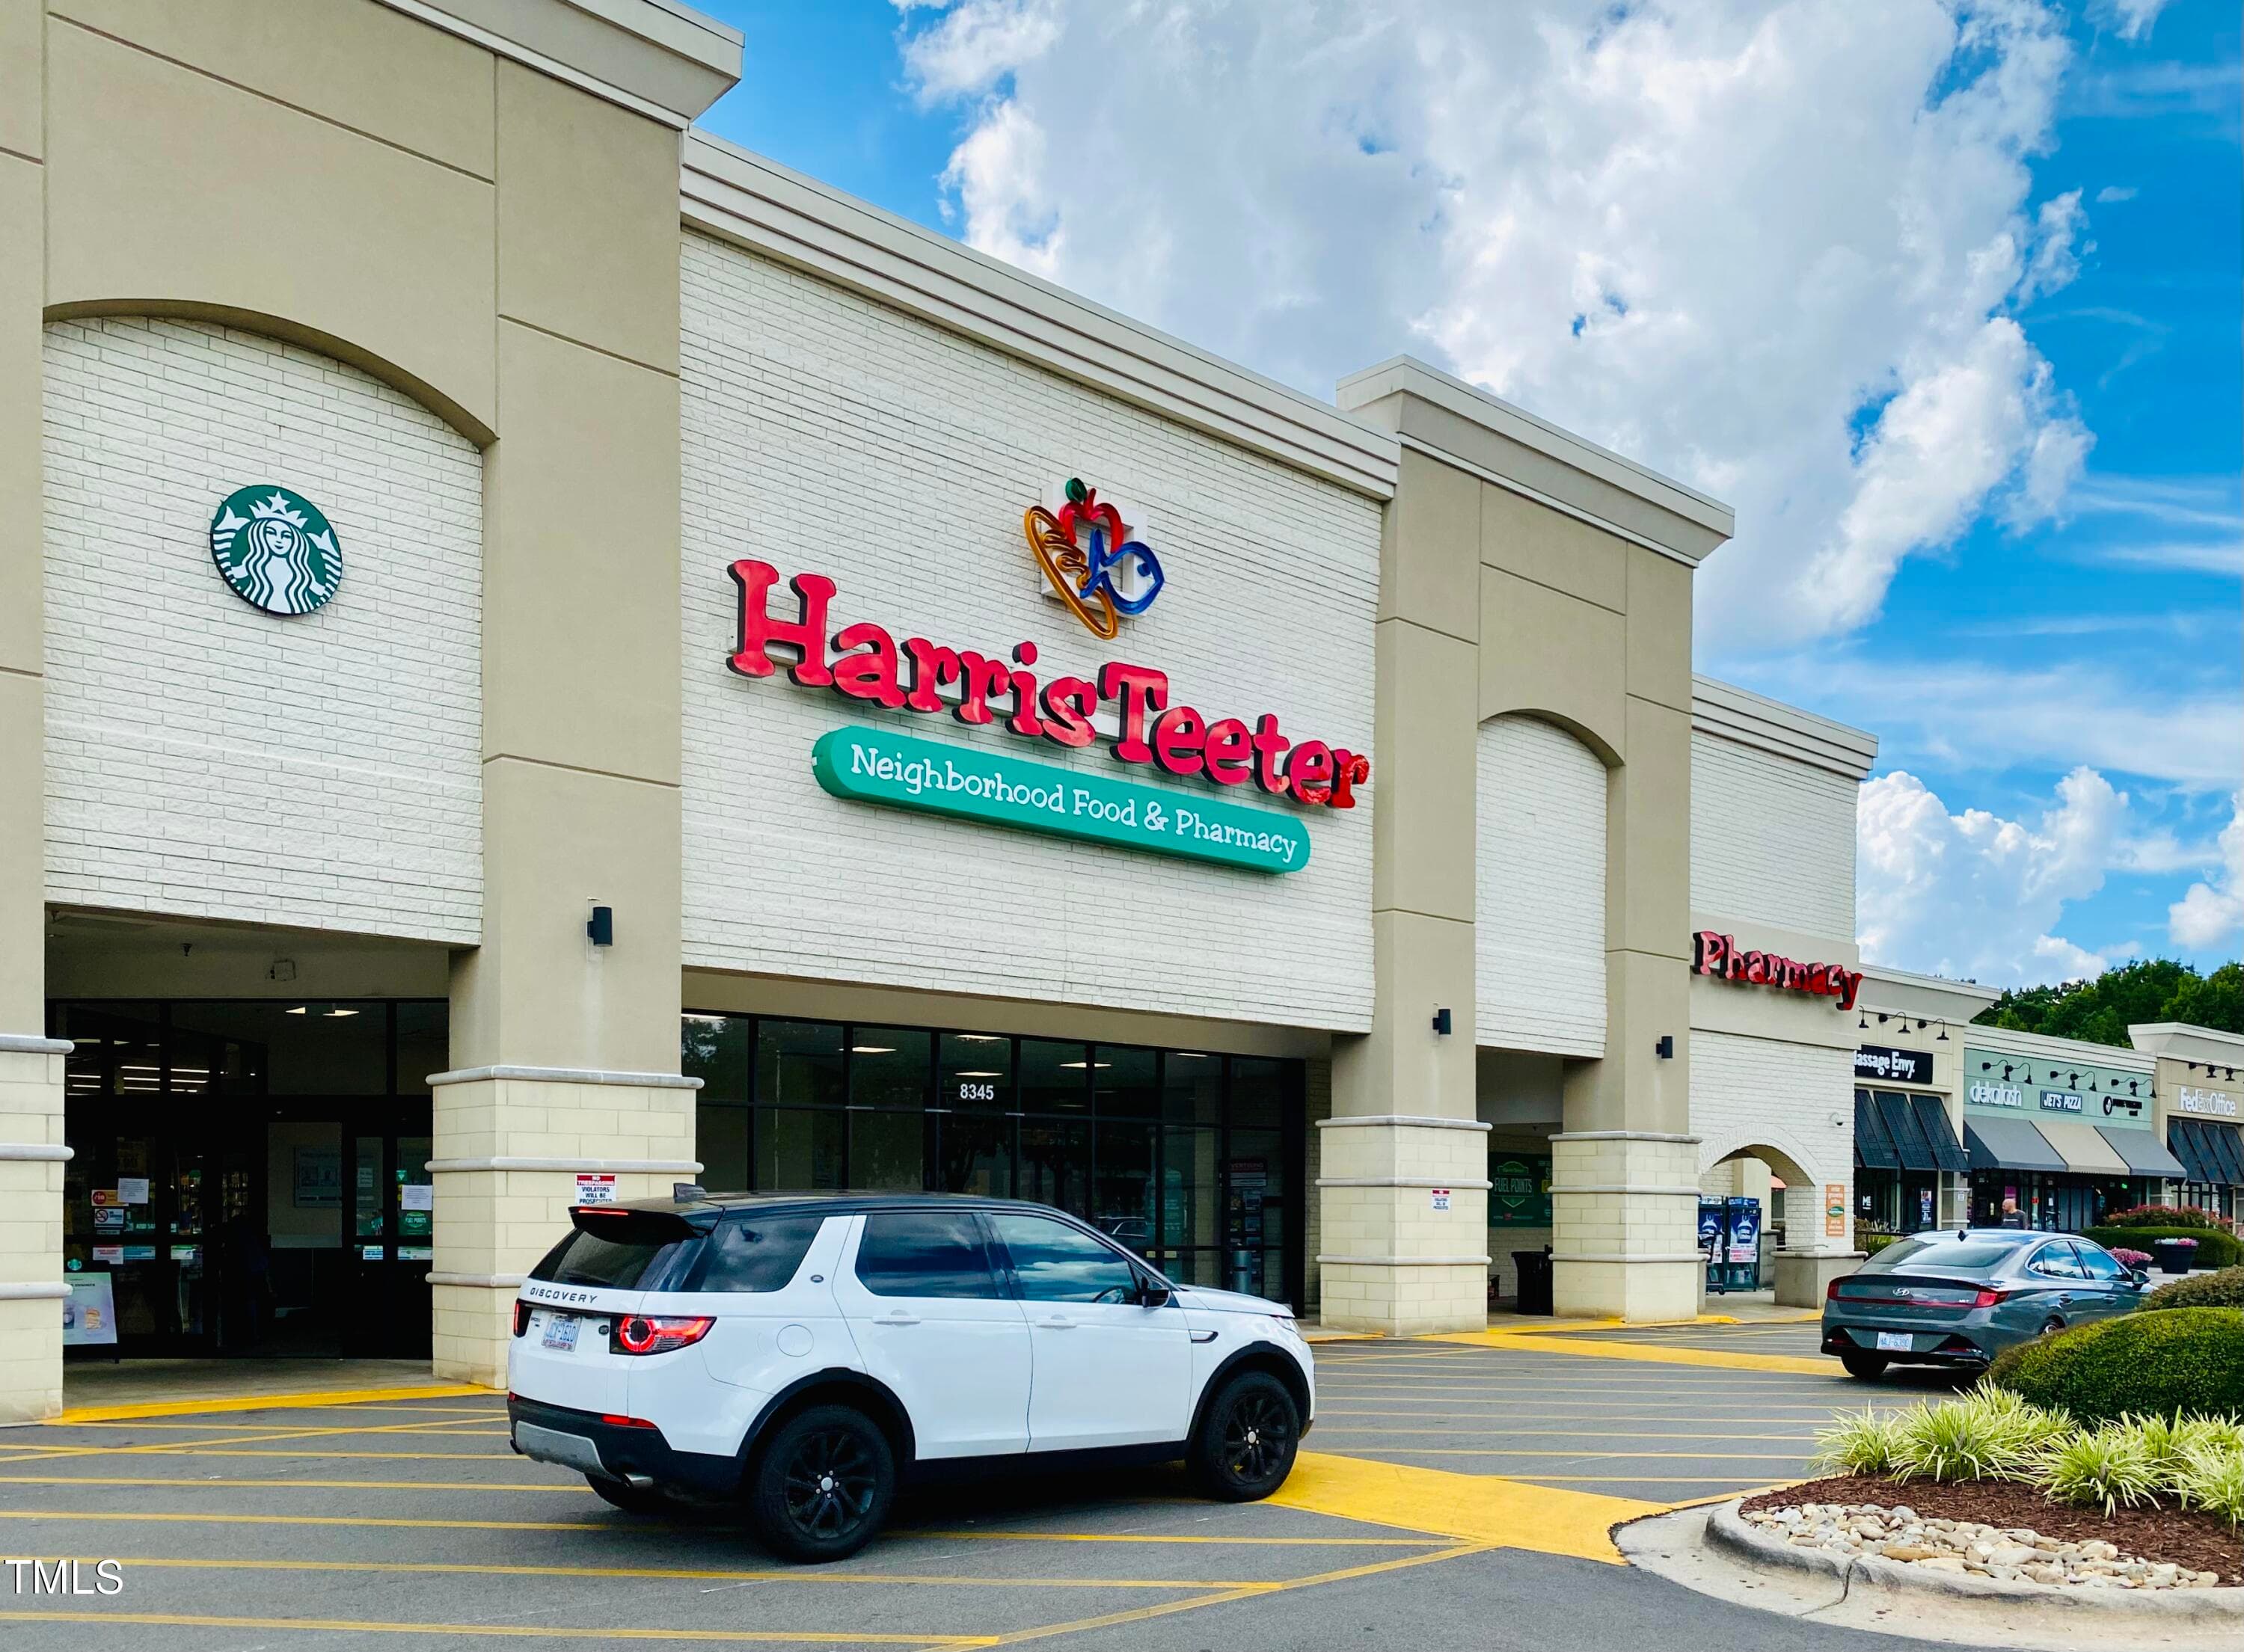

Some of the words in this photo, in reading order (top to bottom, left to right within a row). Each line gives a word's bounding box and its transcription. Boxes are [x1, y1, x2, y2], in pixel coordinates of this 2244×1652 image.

[726, 559, 1097, 749] Harris
[1098, 662, 1370, 809] Teeter
[850, 743, 1065, 814] Neighborhood
[1073, 790, 1137, 829] Food
[1143, 802, 1170, 832] &
[1175, 808, 1299, 865] Pharmacy
[1690, 930, 1863, 1011] Pharmacy
[960, 1083, 994, 1100] 8345
[1969, 1080, 2022, 1107] dekalash
[2044, 1093, 2063, 1108] JET'S
[2063, 1095, 2082, 1111] PIZZA
[1494, 1177, 1509, 1192] FUEL
[1510, 1178, 1532, 1193] POINTS
[530, 1287, 598, 1304] DISCOVERY
